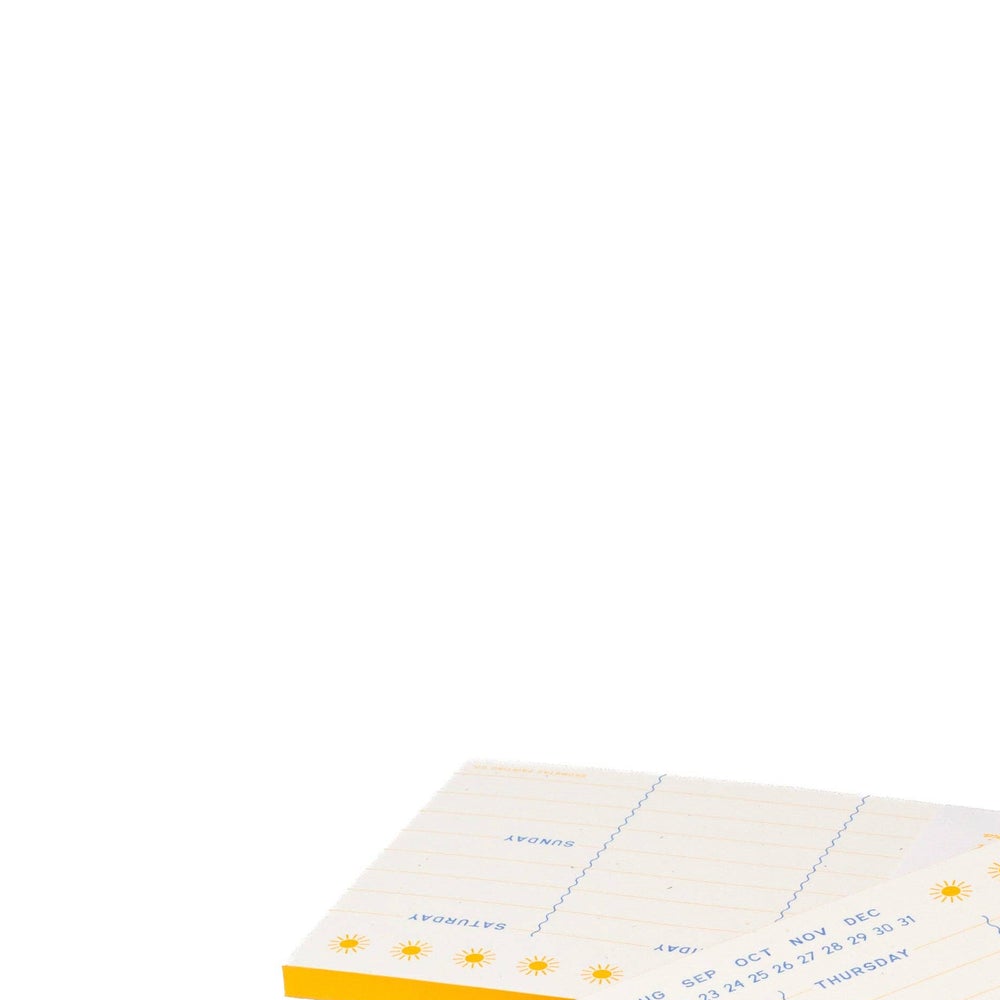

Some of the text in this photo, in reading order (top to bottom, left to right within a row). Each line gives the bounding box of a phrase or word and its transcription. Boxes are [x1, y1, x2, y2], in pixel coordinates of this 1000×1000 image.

[504, 835, 575, 848] SUNDAY
[408, 913, 507, 931] SATURDAY
[653, 944, 703, 954] IDAY
[681, 970, 716, 988] SEP
[734, 947, 771, 967] OCT
[788, 927, 826, 947] NOV
[843, 909, 881, 926] DEC
[723, 979, 745, 993] 24
[748, 970, 769, 983] 25
[772, 961, 794, 974] 26
[797, 951, 814, 964] 27
[821, 942, 843, 955] 28
[847, 933, 867, 945] 29
[872, 923, 894, 936] 30
[897, 915, 916, 926] 31
[814, 947, 910, 990] THURSDAY
